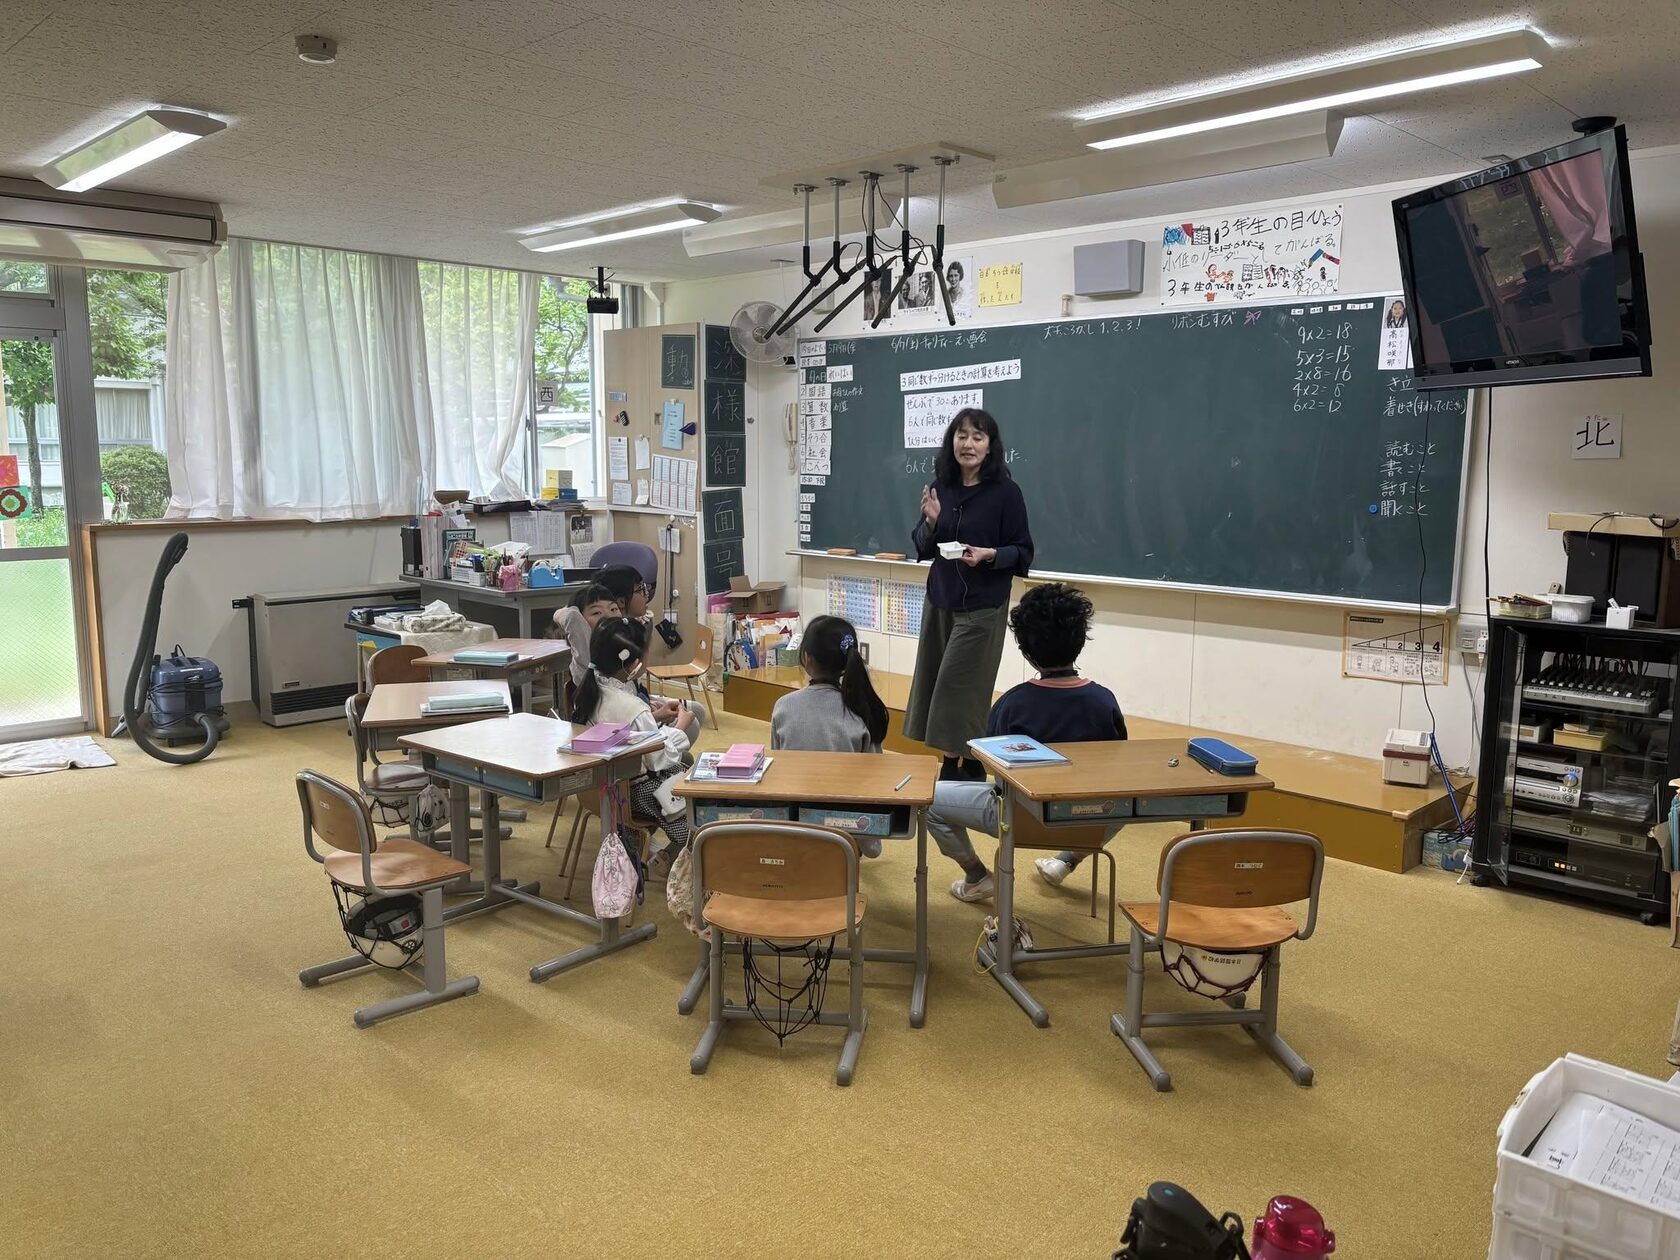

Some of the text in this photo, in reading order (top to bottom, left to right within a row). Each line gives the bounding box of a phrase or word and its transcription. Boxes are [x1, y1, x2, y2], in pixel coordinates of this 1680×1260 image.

[1221, 209, 1342, 237] 3年生の目ひょう
[1171, 311, 1237, 330] リボンむすび
[541, 387, 553, 401] 西
[712, 389, 740, 421] 様
[1576, 421, 1614, 450] 北
[808, 446, 827, 459] 社会
[1384, 440, 1436, 457] 読むこと
[712, 442, 739, 474] 館
[807, 461, 828, 471] こべつ
[1379, 480, 1430, 497] 話すこと
[1381, 499, 1429, 517] 聞くこと
[1398, 642, 1403, 650] 2
[1415, 641, 1421, 651] 3
[1433, 641, 1440, 652] 4
